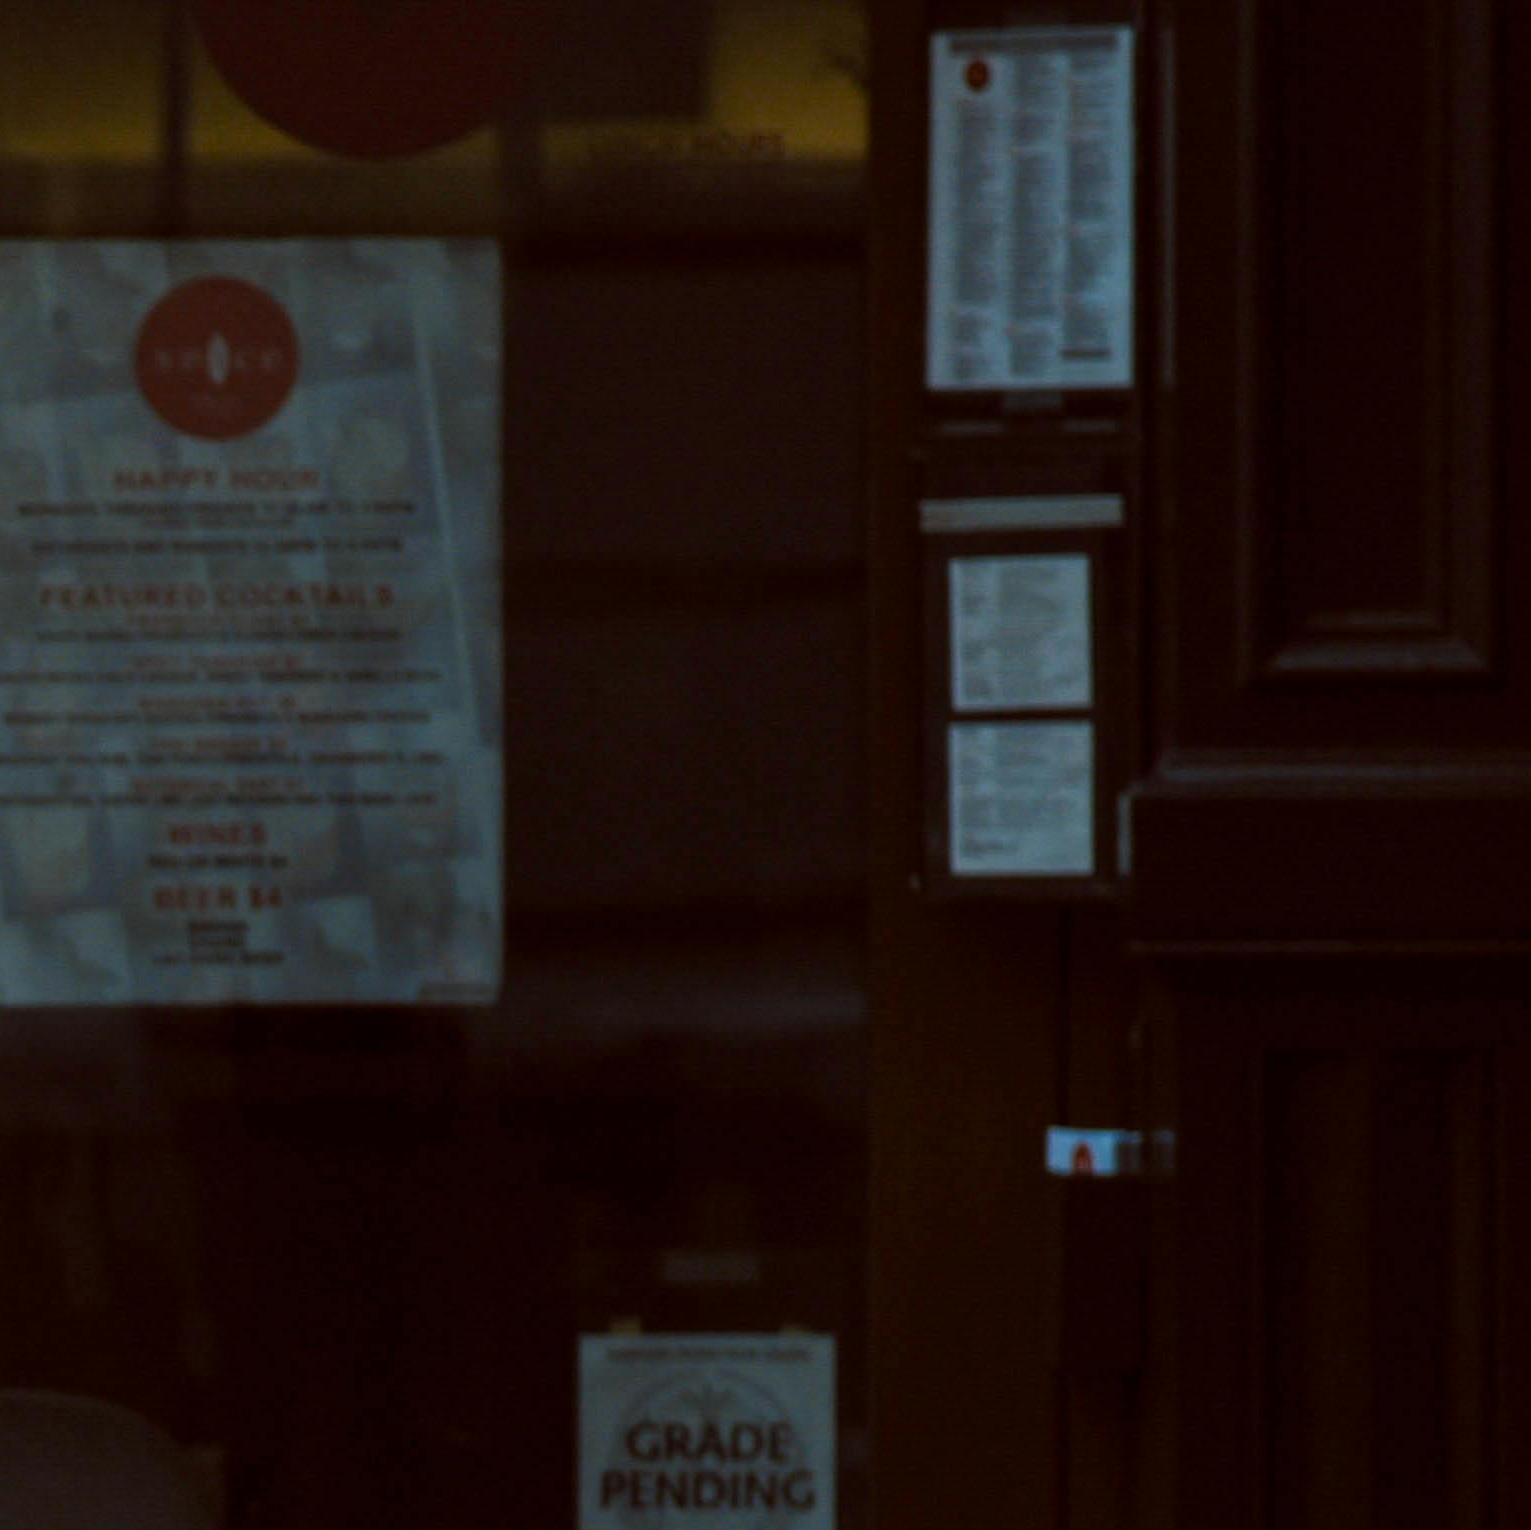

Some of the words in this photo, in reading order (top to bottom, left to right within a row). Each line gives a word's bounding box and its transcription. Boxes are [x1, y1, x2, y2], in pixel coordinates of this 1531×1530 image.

[113, 468, 218, 490] HAPPY
[230, 468, 320, 490] HOUR
[38, 583, 207, 609] FEATURED
[215, 583, 395, 609] COCKTAILS
[167, 822, 267, 844] WINES
[154, 886, 236, 910] BEER
[625, 1421, 794, 1463] GRADE
[599, 1471, 817, 1511] PENDING
